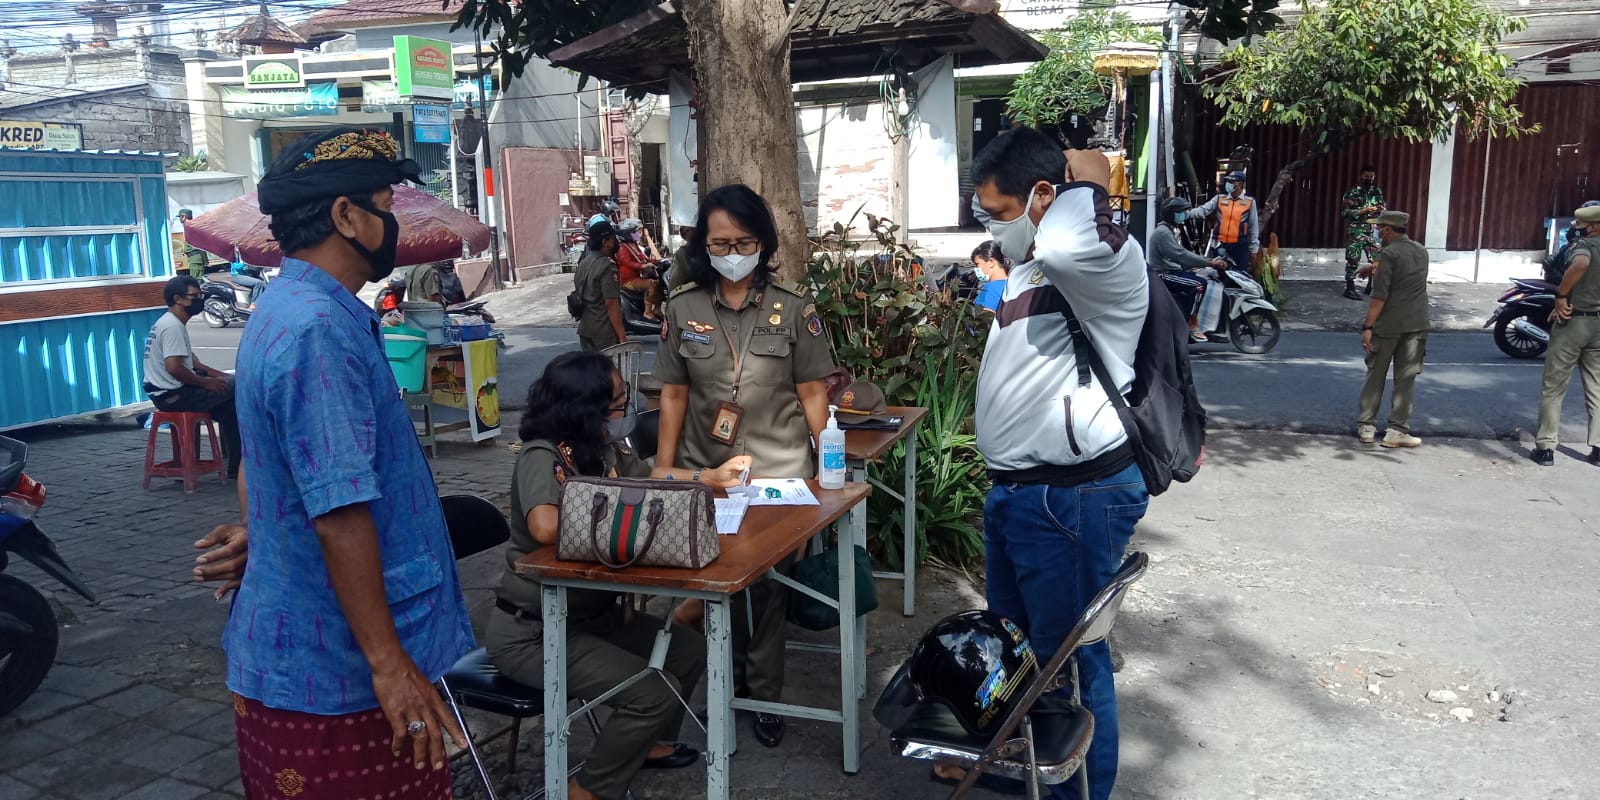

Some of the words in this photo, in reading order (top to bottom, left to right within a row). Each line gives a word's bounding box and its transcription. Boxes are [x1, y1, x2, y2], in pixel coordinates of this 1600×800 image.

[1026, 5, 1064, 16] BERAS
[250, 73, 295, 82] SANJAYA
[226, 99, 285, 115] STUDIO
[293, 97, 338, 112] FOTO
